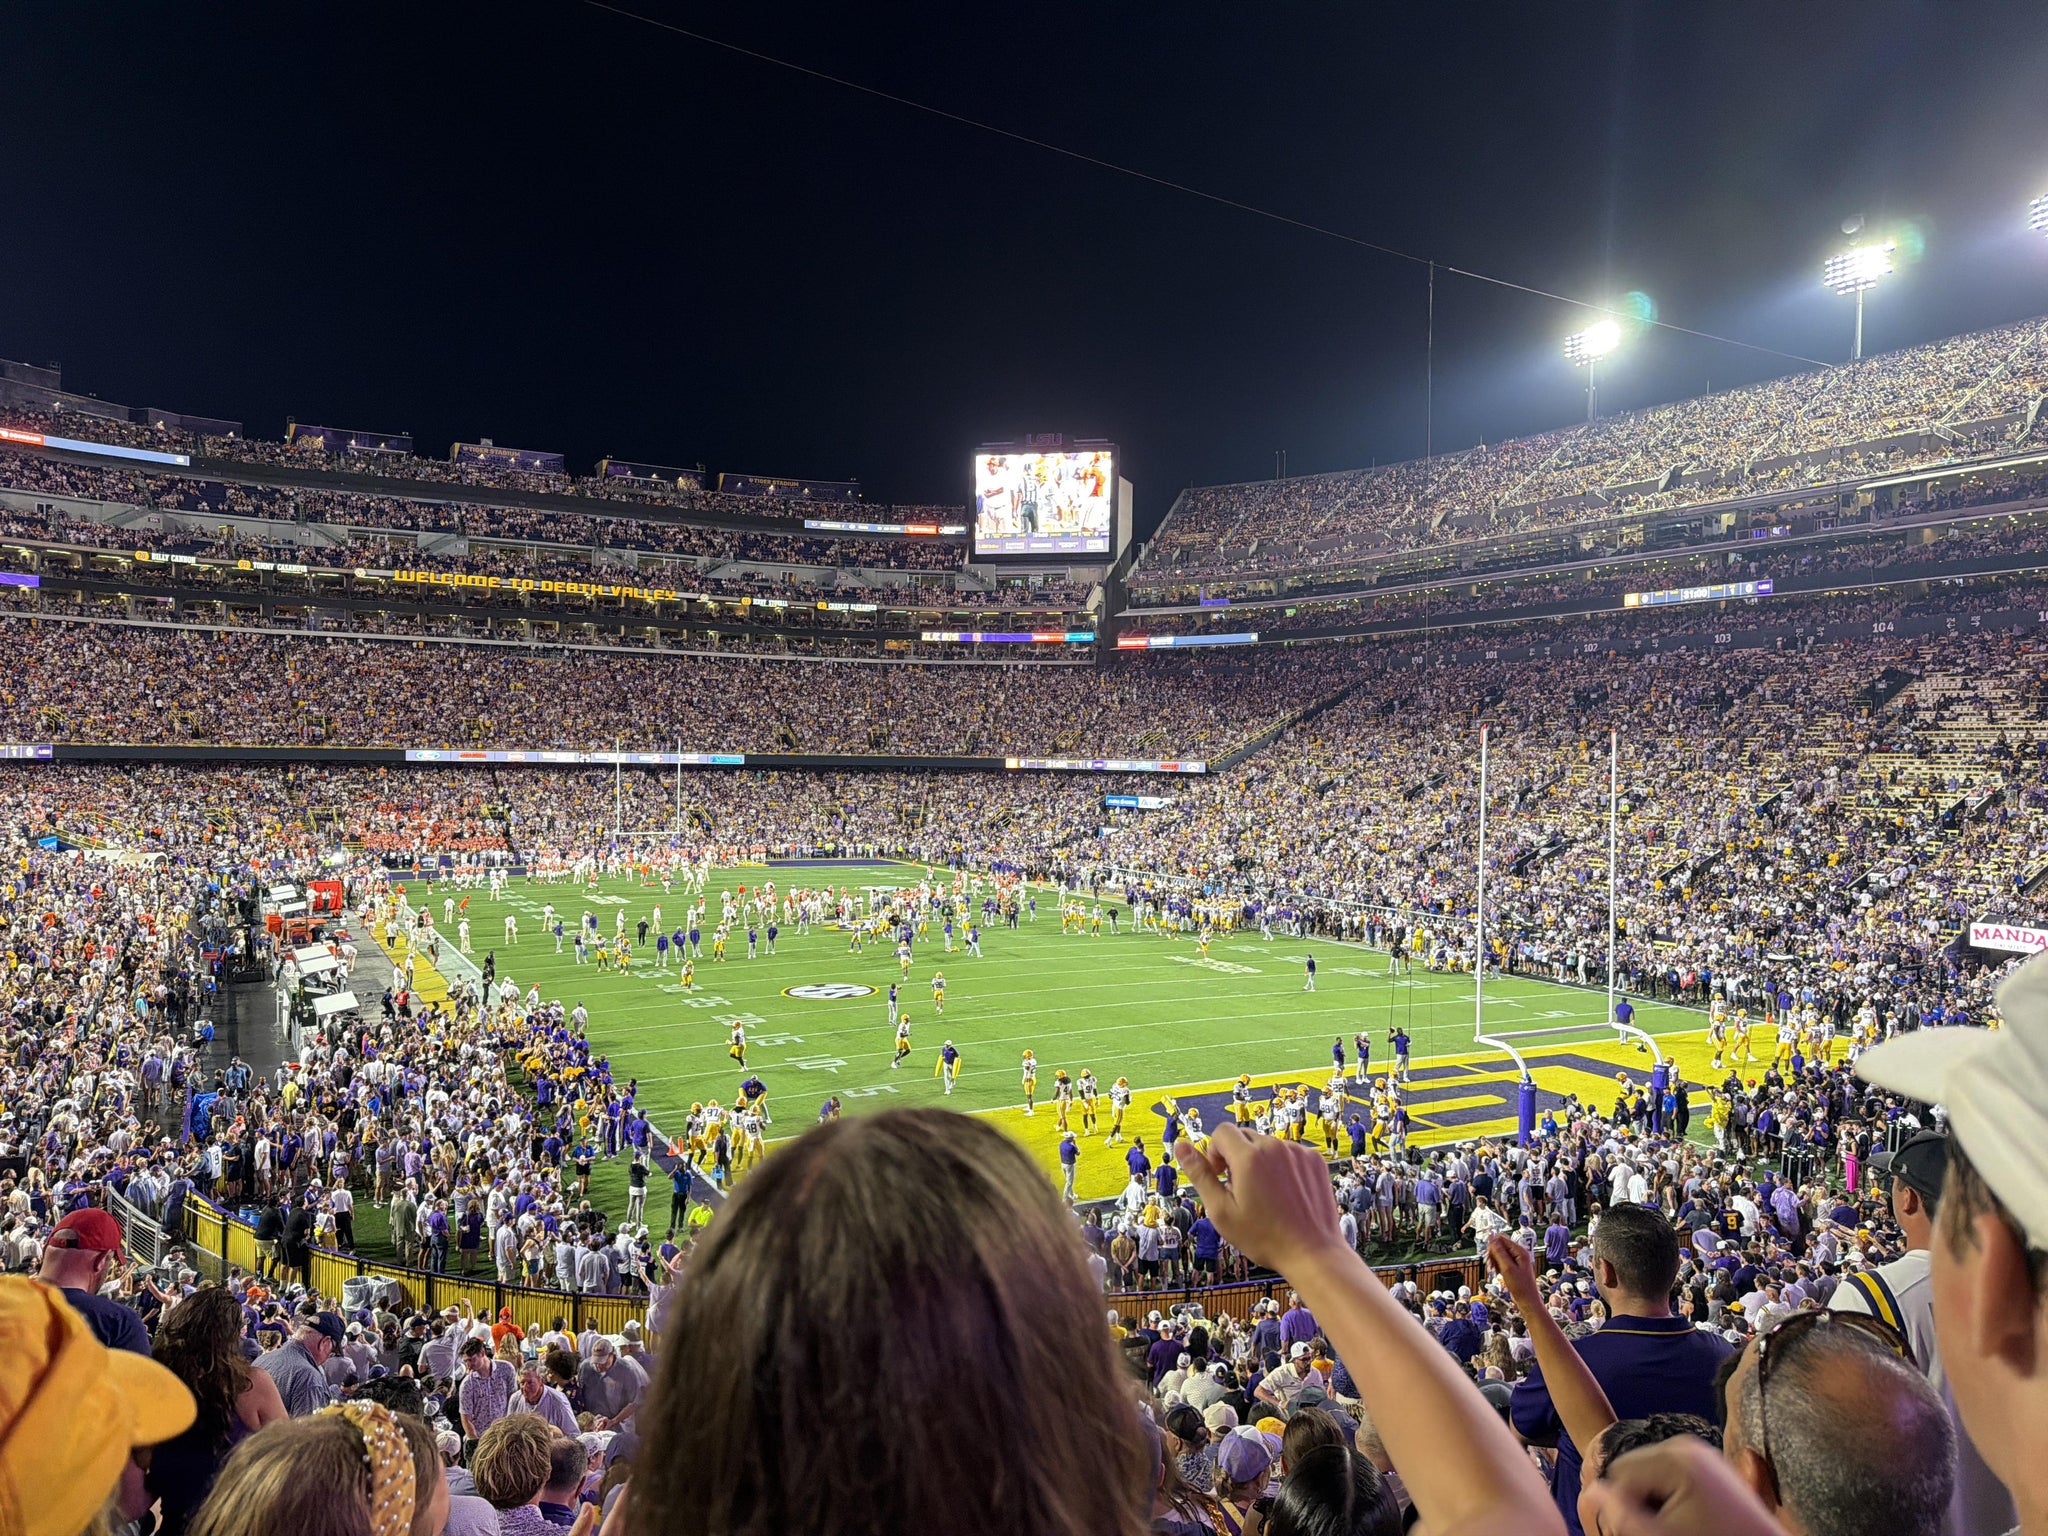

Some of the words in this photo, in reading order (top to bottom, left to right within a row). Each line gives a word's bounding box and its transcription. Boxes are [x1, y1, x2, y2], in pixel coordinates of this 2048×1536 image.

[1026, 433, 1062, 447] LSU
[468, 446, 489, 454] TIGER
[490, 448, 521, 457] STADIUM
[393, 569, 501, 588] WELCOME
[508, 578, 534, 591] TO
[541, 580, 603, 595] DEATH
[610, 586, 677, 601] VALLEY
[1872, 622, 1895, 633] 104
[1714, 633, 1732, 644] 103
[1583, 643, 1598, 653] 102
[1485, 651, 1498, 659] 101
[1973, 927, 2048, 949] MANDA
[1782, 1031, 1793, 1040] 77
[1332, 1083, 1344, 1093] 22
[706, 1108, 719, 1117] 97
[745, 1123, 758, 1133] 48
[1532, 1177, 1542, 1185] 22
[1727, 1216, 1737, 1230] 9
